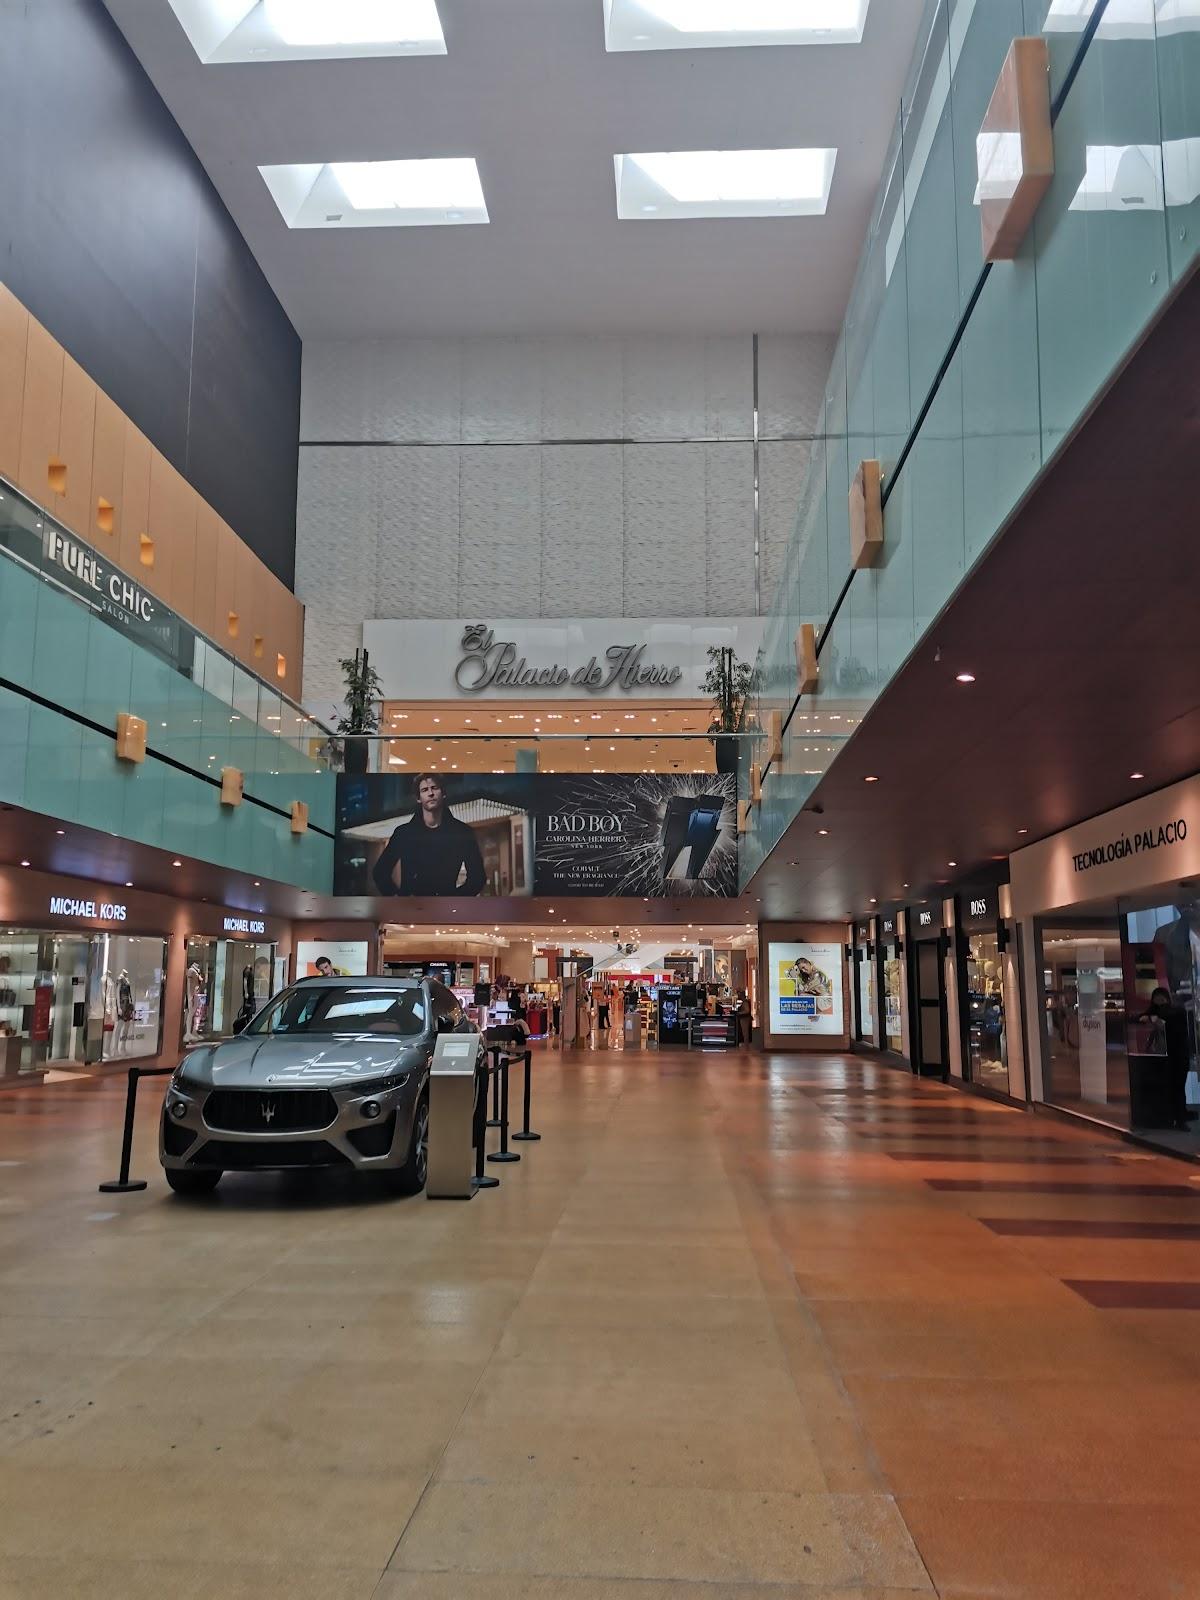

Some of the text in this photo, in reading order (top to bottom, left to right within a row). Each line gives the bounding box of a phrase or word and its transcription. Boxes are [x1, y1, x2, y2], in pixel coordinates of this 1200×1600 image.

[49, 532, 151, 622] PURE CHIC
[102, 600, 130, 625] SALON
[461, 624, 496, 651] El
[455, 642, 683, 692] Palacio de Hierro
[548, 815, 623, 833] BAD BOY
[545, 835, 627, 843] CAROLINA HERRERA
[1072, 819, 1187, 872] TECNOLOGÍA PALACIO
[50, 896, 127, 921] MICHAEL KORS
[970, 898, 987, 916] BOSS
[223, 917, 265, 934] MICHAEL KORS
